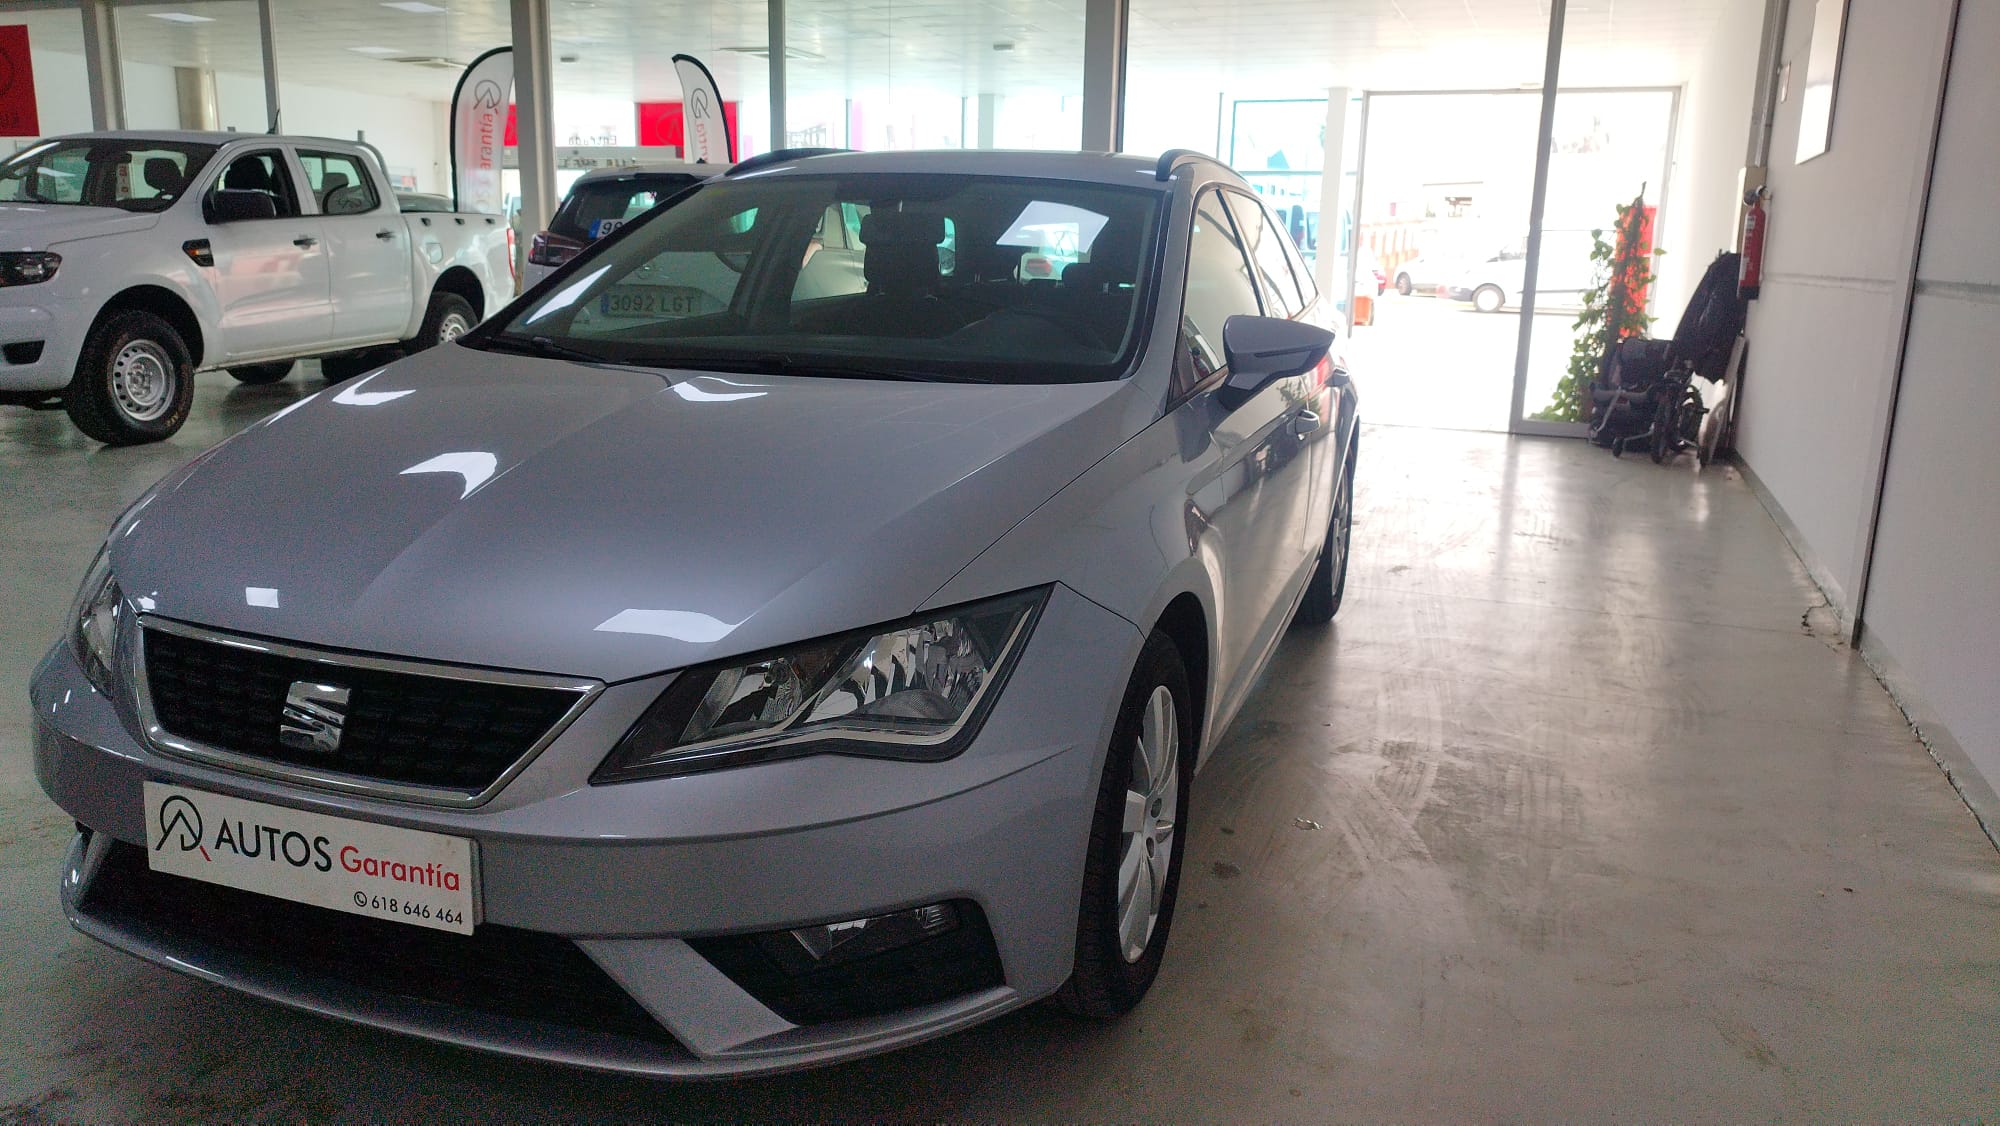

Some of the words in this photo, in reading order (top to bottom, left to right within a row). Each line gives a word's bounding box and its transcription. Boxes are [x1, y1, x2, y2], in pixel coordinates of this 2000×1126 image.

[480, 113, 492, 186] arantía
[610, 294, 655, 312] 3092
[660, 296, 694, 312] LGT
[214, 817, 332, 872] AUTOS
[340, 845, 461, 891] Garantía
[371, 895, 398, 913] 618
[403, 901, 430, 919] 646
[435, 908, 464, 925] 464
